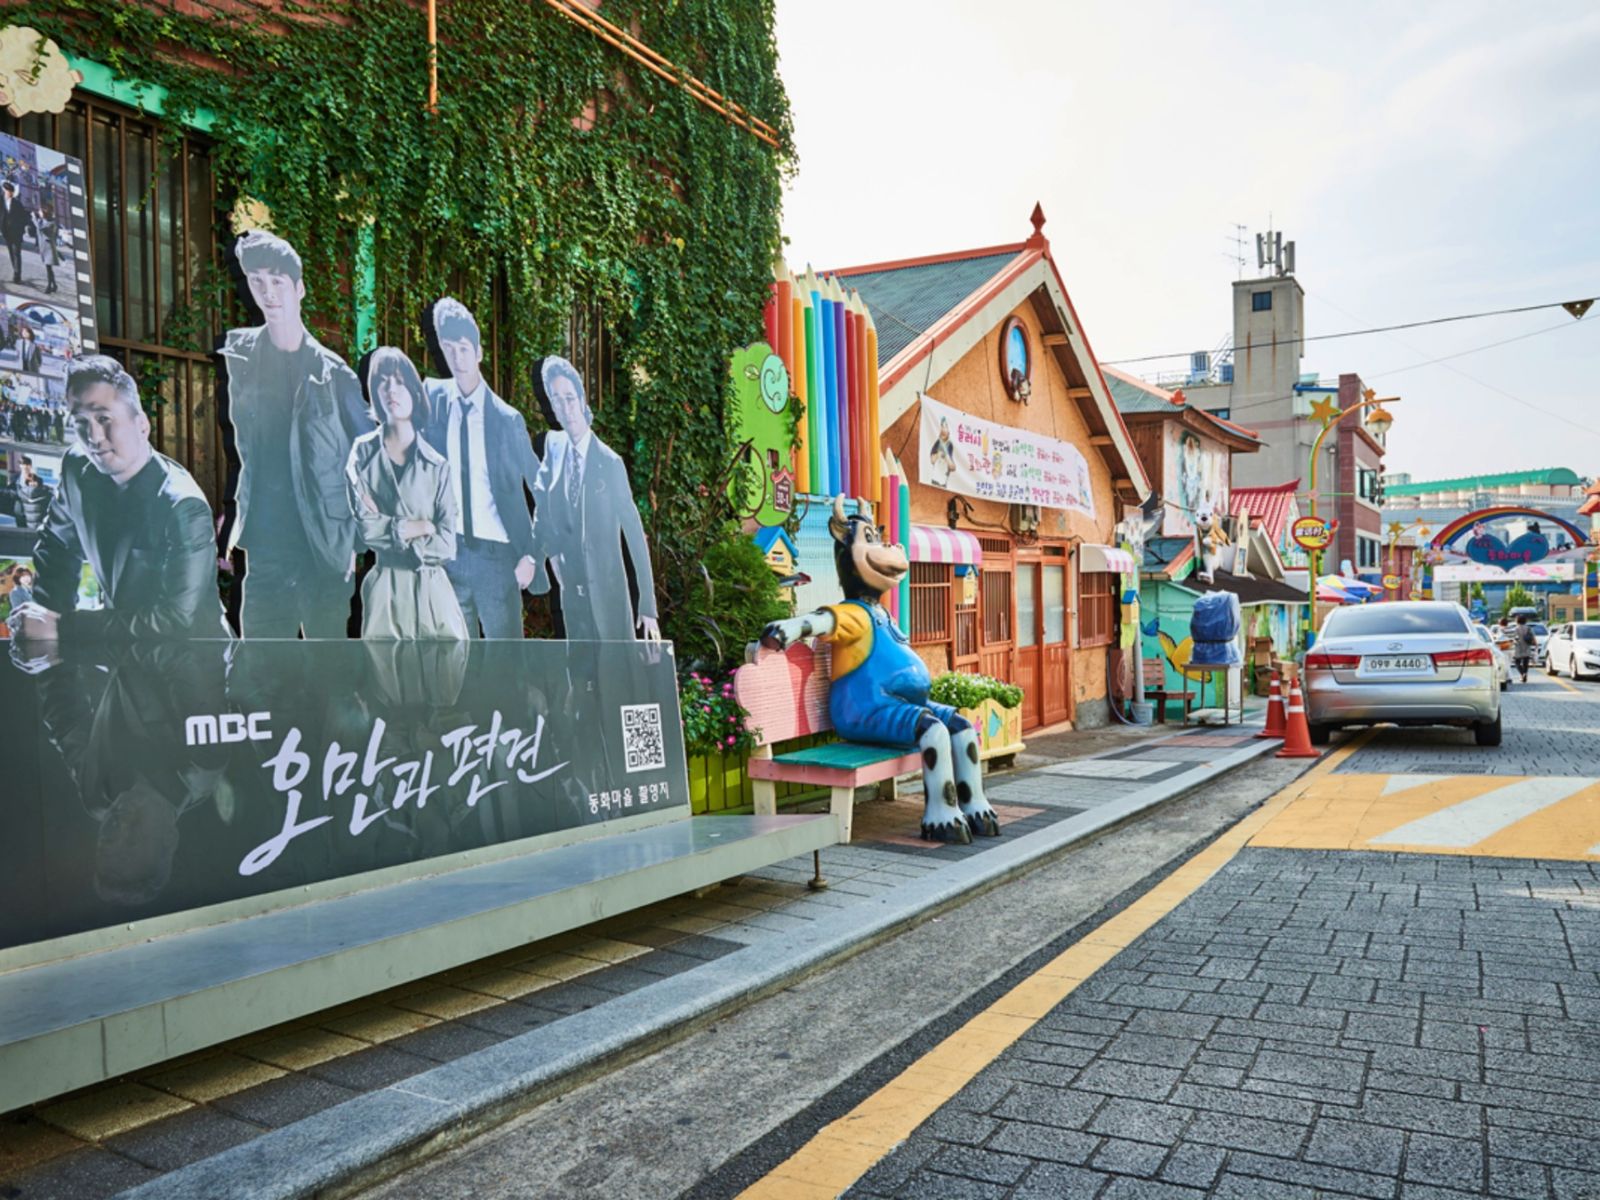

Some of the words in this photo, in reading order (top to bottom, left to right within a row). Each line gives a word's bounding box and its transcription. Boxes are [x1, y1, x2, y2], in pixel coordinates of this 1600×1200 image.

[1395, 658, 1421, 668] 4440
[185, 711, 272, 745] MBC
[239, 717, 440, 876] 오만과
[441, 710, 570, 807] 편견
[588, 787, 633, 814] 동화마을
[637, 782, 670, 805] 촬영지
